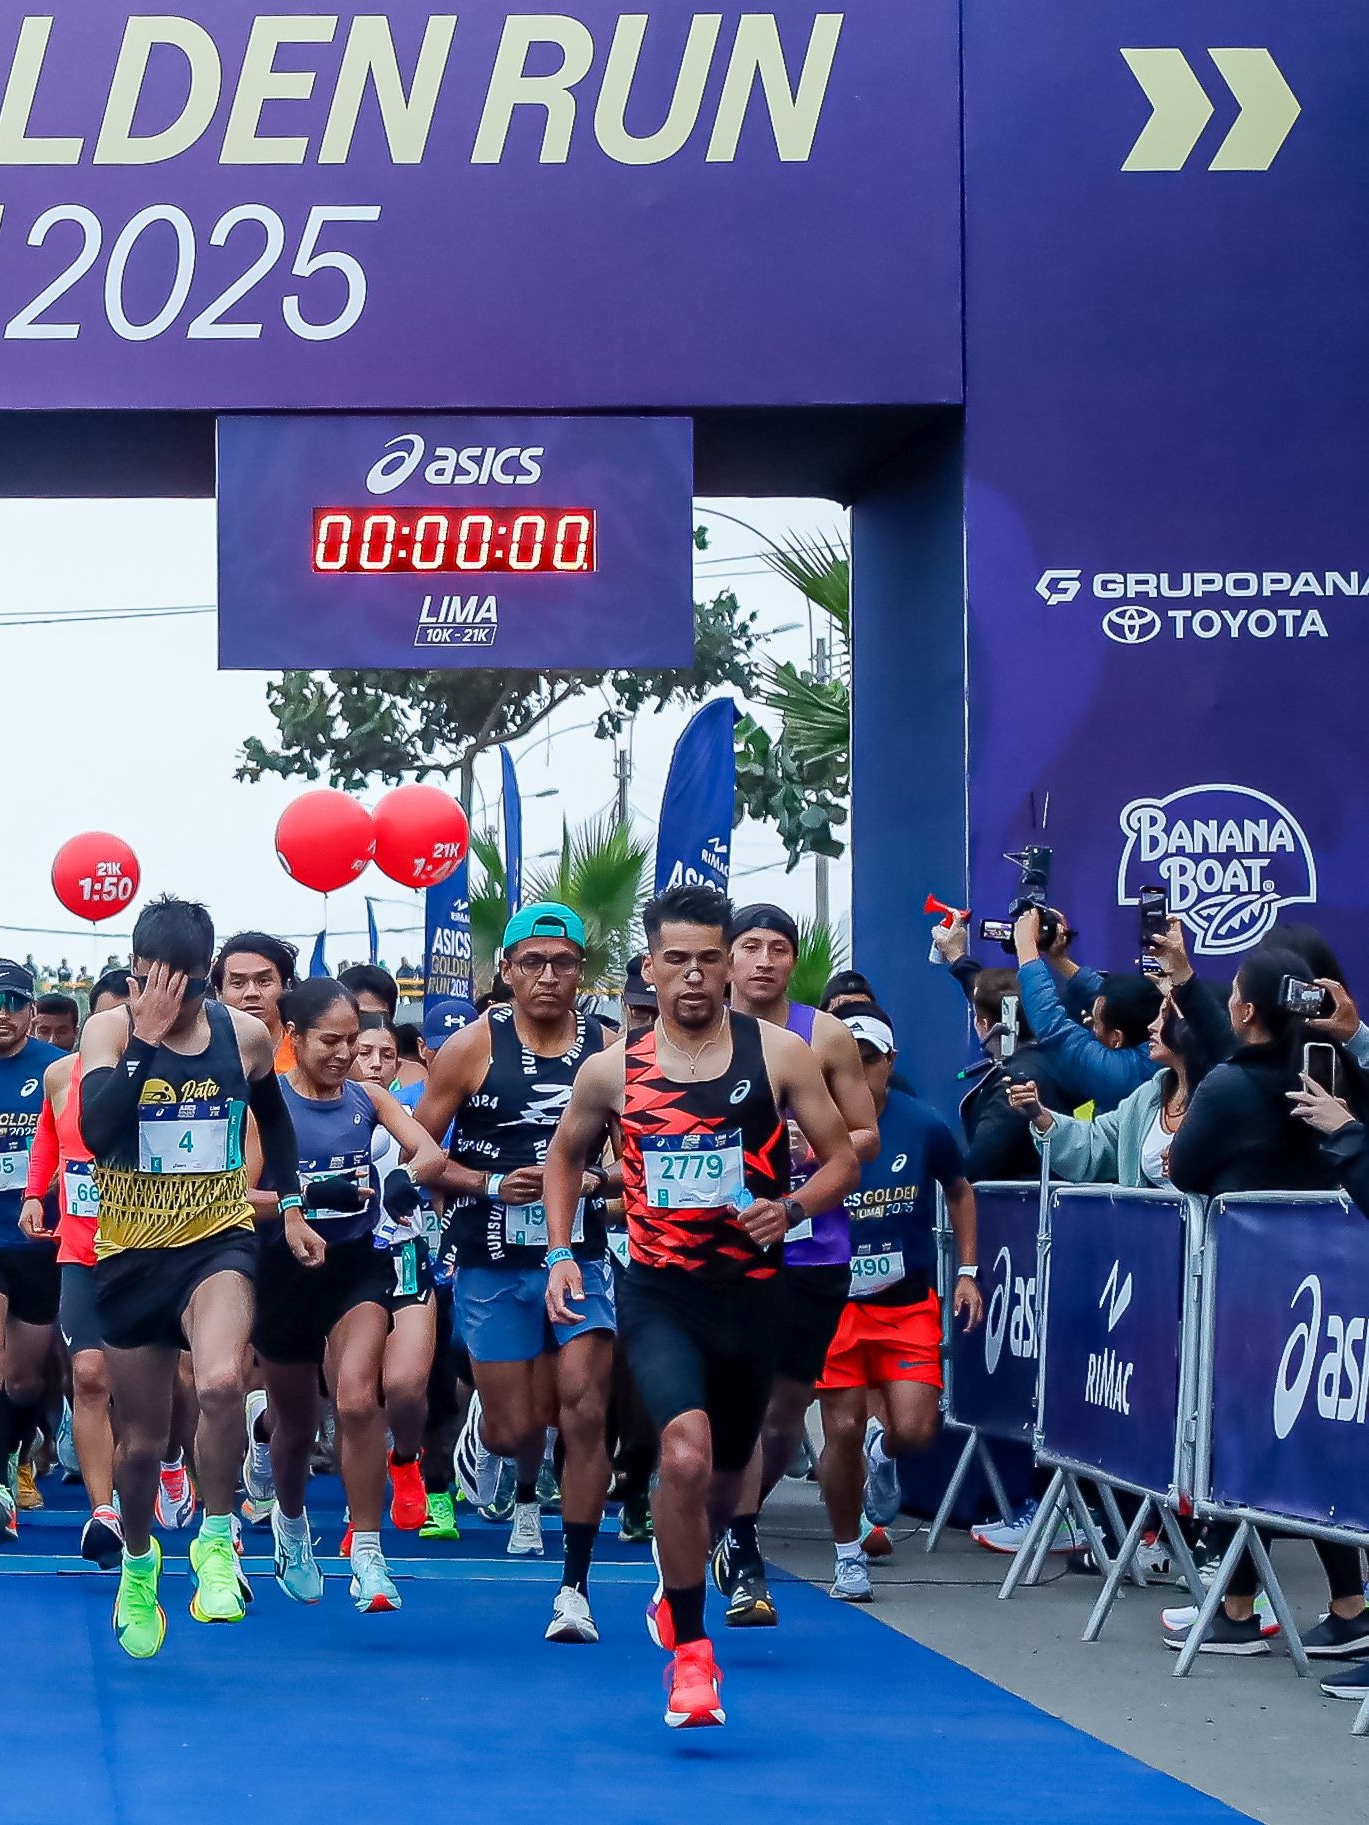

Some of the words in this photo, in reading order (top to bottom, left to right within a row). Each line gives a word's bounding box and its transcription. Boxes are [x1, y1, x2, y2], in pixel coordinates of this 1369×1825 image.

[471, 13, 844, 166] RUN
[4, 204, 381, 342] 2025
[424, 446, 545, 485] asics
[314, 514, 590, 571] 00:00:00
[420, 595, 498, 624] LIMA
[1167, 608, 1329, 639] TOYOTA
[1129, 808, 1295, 862] BANANA
[95, 861, 122, 877] 21K
[78, 876, 133, 902] 1:50
[431, 926, 471, 959] ASICS
[178, 1130, 194, 1153] 4
[660, 1154, 724, 1180] 2779
[77, 1182, 100, 1202] 66
[862, 1185, 919, 1205] GOLDEN
[521, 1205, 546, 1227] 19
[1084, 1348, 1134, 1416] RIMAC
